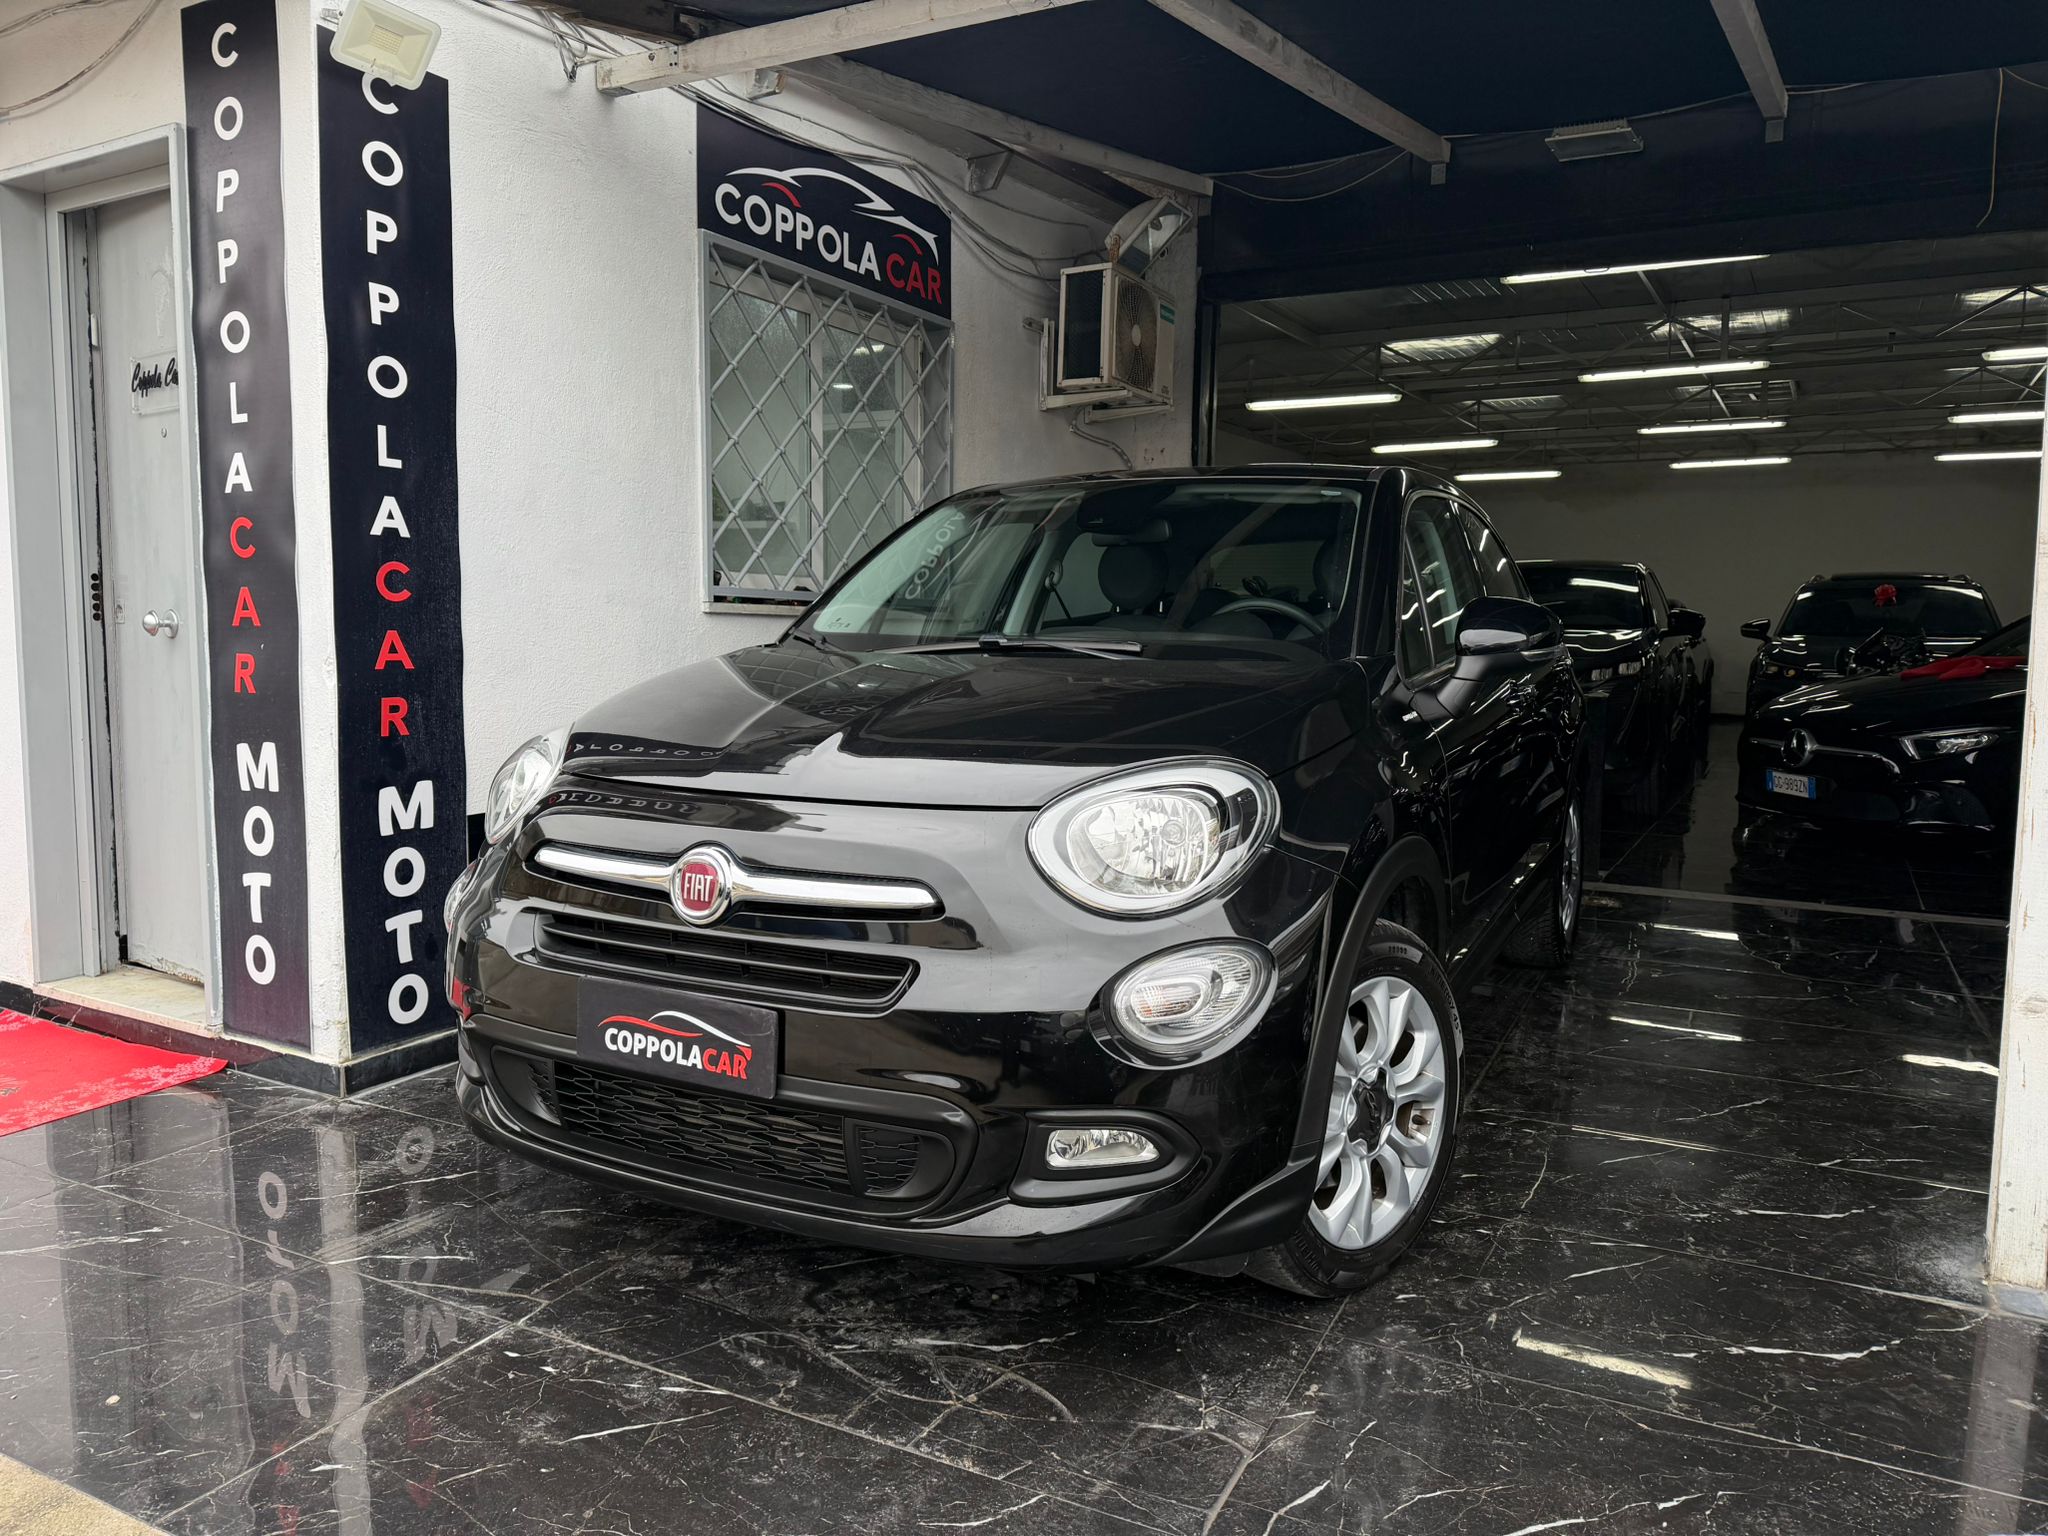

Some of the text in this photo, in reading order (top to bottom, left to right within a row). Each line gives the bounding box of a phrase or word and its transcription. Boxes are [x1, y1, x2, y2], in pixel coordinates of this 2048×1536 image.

[237, 742, 280, 985] MOTO
[379, 780, 434, 1024] MOTO
[683, 872, 714, 902] FIAT
